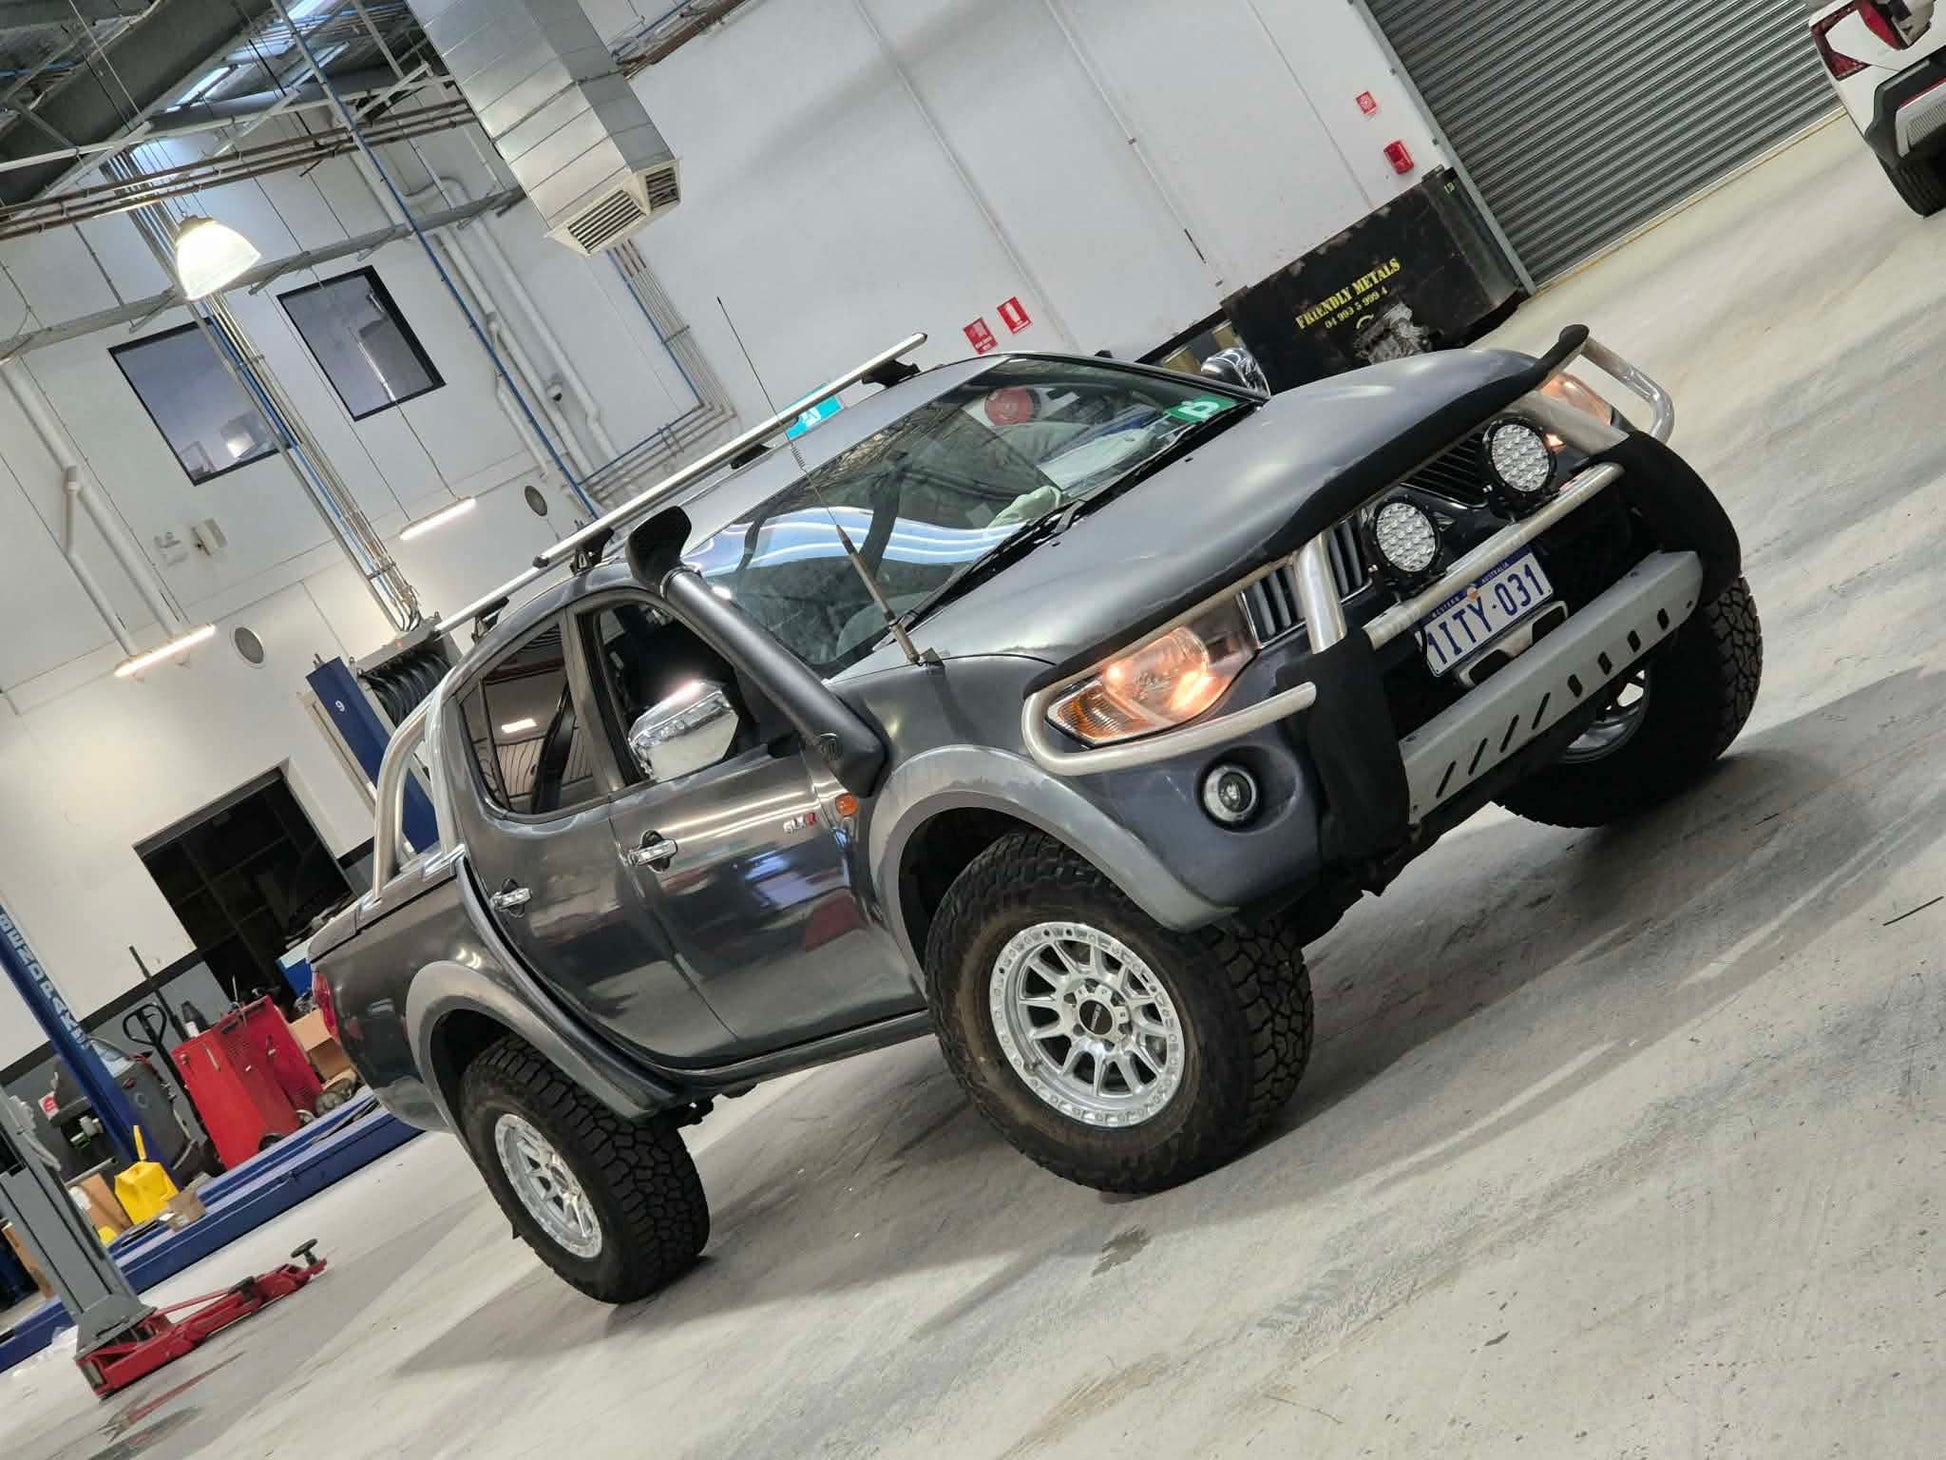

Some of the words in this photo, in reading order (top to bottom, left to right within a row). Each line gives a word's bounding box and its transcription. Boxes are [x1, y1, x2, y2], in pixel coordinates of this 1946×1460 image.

[1295, 286, 1352, 329] FRIENDLY
[1352, 258, 1400, 295] METALS
[335, 699, 346, 712] 9
